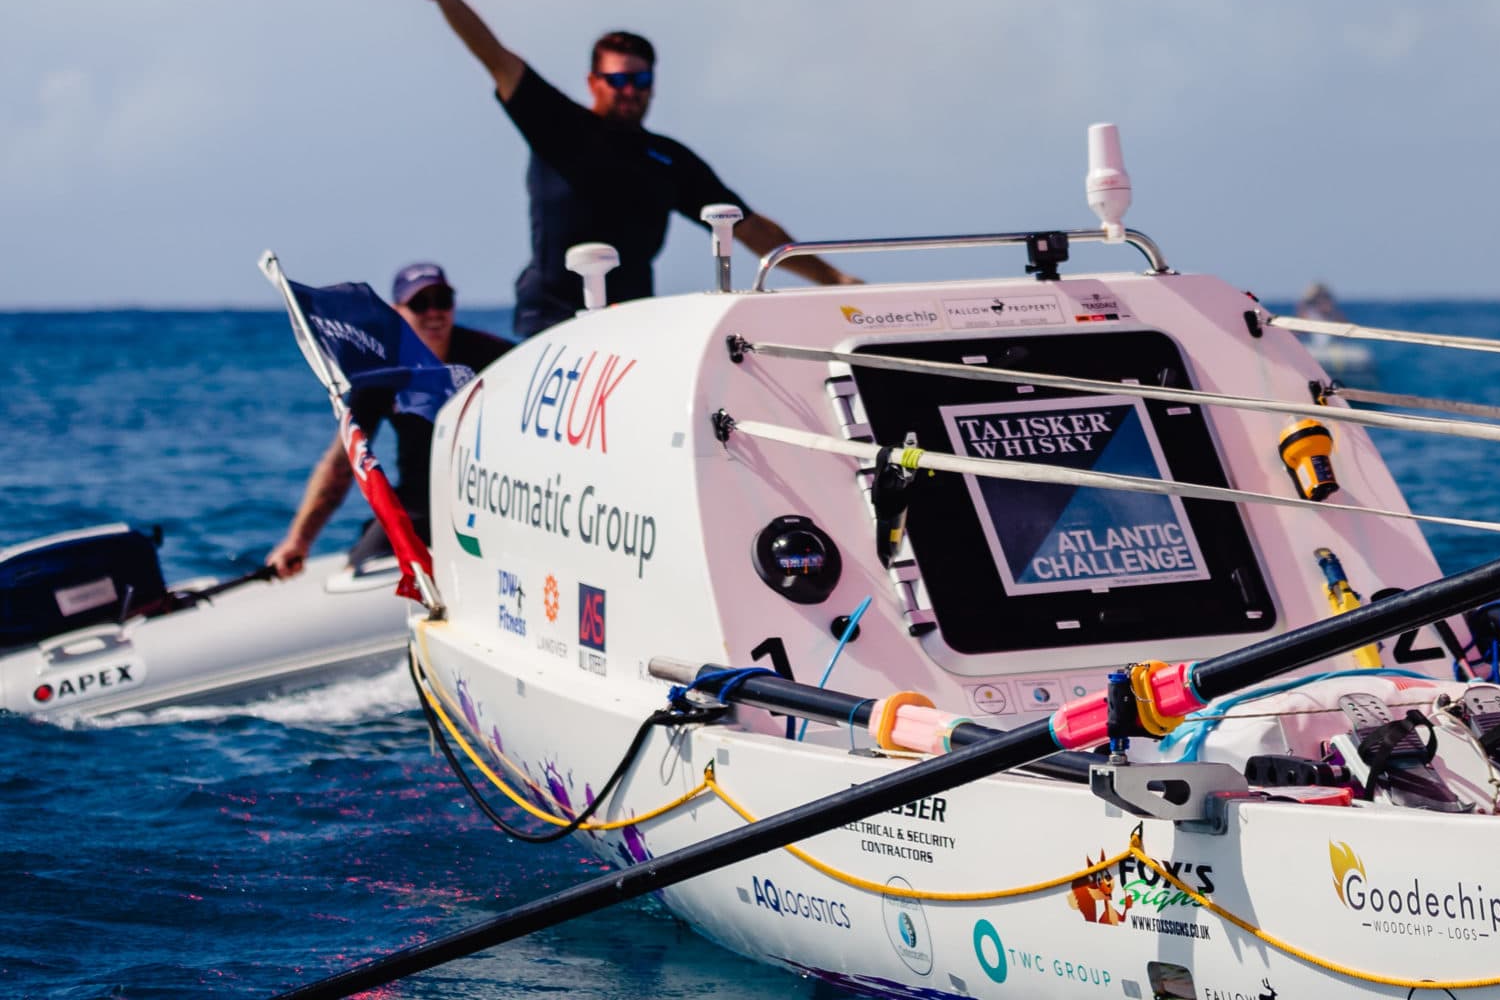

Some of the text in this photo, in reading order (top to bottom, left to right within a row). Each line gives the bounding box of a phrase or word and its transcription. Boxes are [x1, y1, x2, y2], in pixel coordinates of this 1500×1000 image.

[852, 311, 938, 325] Goodechip
[1008, 303, 1058, 312] PROPERTY
[521, 343, 637, 454] VetUK
[959, 413, 1112, 442] TALISKER
[971, 434, 1094, 459] WHISKY
[455, 446, 657, 579] Vencomatic Group
[1058, 523, 1184, 554] ATLANTIC
[1033, 546, 1195, 579] CHALLENGE
[498, 605, 527, 637] Fitness
[58, 664, 133, 698] APEX
[861, 839, 934, 864] CONTRACTORS
[897, 828, 905, 841] &
[907, 830, 956, 849] SECURITY
[1118, 855, 1216, 894] FOX'S
[1373, 920, 1433, 937] WOODCHIP
[1447, 927, 1478, 941] LOGS
[1008, 948, 1112, 987] TWC GROUP
